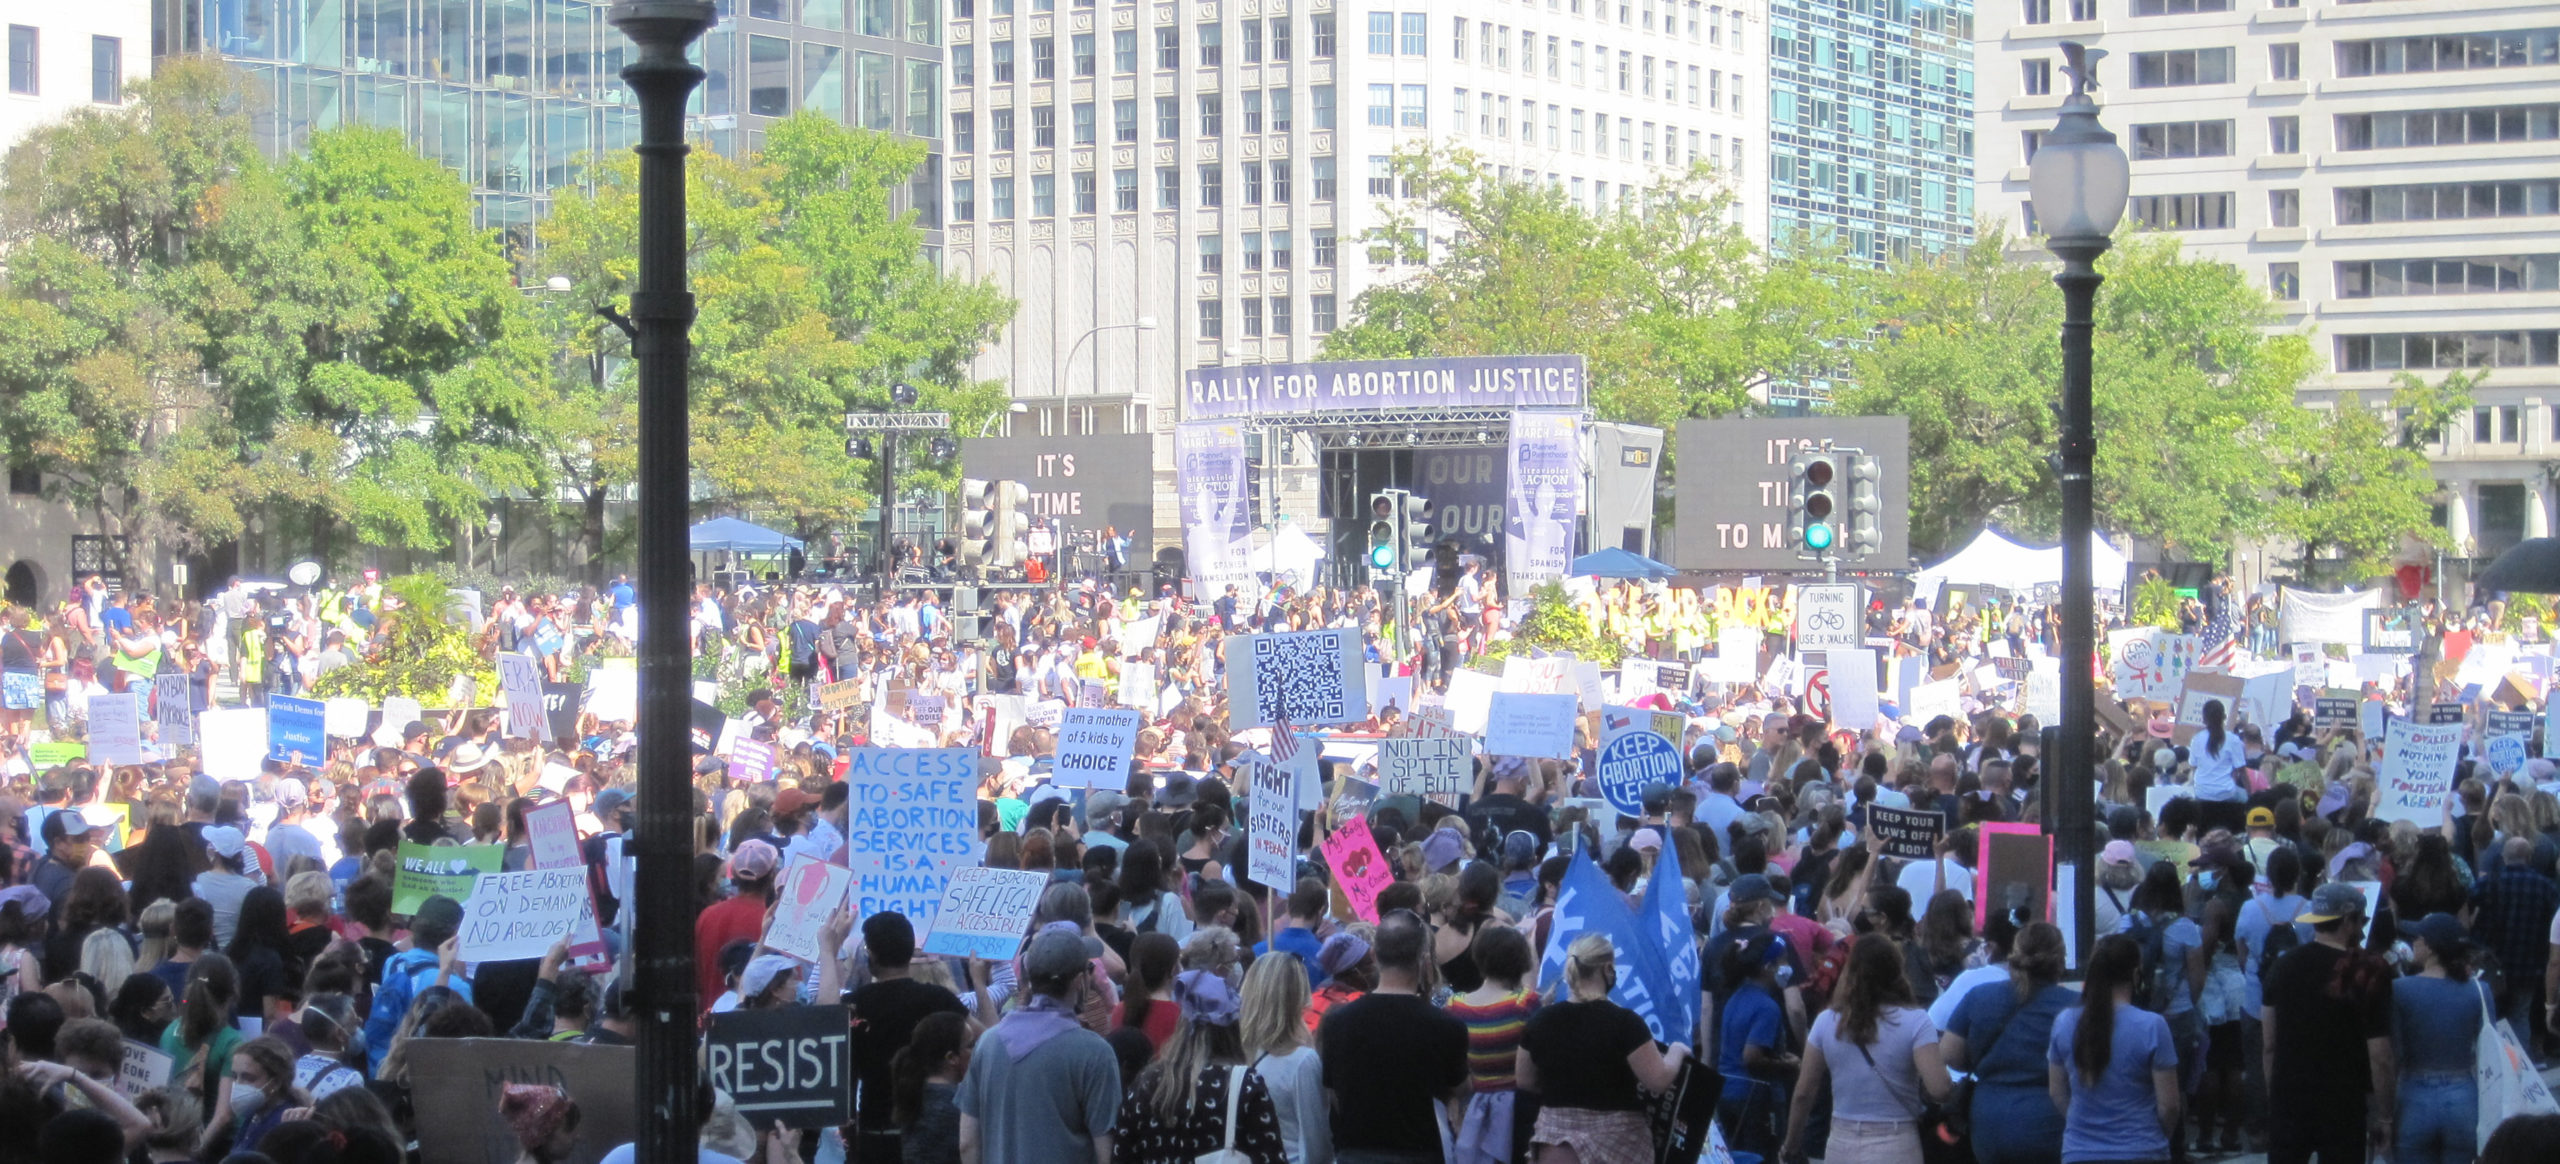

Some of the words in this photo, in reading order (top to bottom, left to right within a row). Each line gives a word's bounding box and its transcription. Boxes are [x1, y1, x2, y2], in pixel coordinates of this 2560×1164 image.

[1191, 376, 1260, 403] RALLY
[1273, 374, 1318, 399] FOR
[1331, 369, 1455, 397] ABORTION
[1468, 367, 1576, 393] JUSTICE
[1181, 437, 1214, 449] MARCH
[1515, 428, 1549, 439] MARCH
[1036, 454, 1075, 477] IT'S
[1429, 455, 1492, 484] OUR
[1526, 475, 1568, 485] ACTION
[1030, 491, 1082, 515] TIME
[1441, 504, 1503, 534] OUR
[1717, 524, 1748, 549] TO
[1230, 547, 1246, 556] FOR
[1550, 546, 1565, 555] FOR
[1213, 561, 1247, 570] SPANISH
[1530, 559, 1564, 568] SPANISH
[1809, 591, 1845, 603] TURNING
[1800, 634, 1816, 644] USE
[502, 660, 538, 695] ERA
[1528, 661, 1555, 680] YOU
[159, 676, 171, 697] MY
[1518, 674, 1564, 694] DON'T
[270, 701, 294, 713] Jewish
[294, 704, 314, 716] Dems
[314, 707, 325, 717] for
[511, 701, 543, 728] NOW
[1065, 711, 1069, 723] I
[1071, 715, 1085, 725] am
[1088, 715, 1094, 725] a
[1096, 713, 1133, 727] mother
[283, 730, 311, 744] Justice
[1067, 730, 1079, 743] of
[1080, 731, 1086, 744] 5
[1088, 731, 1110, 745] kids
[1111, 732, 1124, 748] by
[1610, 733, 1660, 761] KEEP
[1385, 739, 1425, 758] NOT
[1434, 738, 1464, 756] IN
[2398, 748, 2448, 762] NOTHING
[853, 752, 972, 777] ACCESS
[1062, 752, 1118, 772] CHOICE
[1392, 757, 1460, 777] SPITE
[1601, 750, 1678, 787] ABORTION
[1254, 761, 1292, 798] FIGHT
[2405, 767, 2441, 781] YOUR
[856, 783, 889, 804] TO
[899, 780, 964, 804] SAFE
[1424, 776, 1460, 794] BUT
[1257, 789, 1269, 807] for
[1271, 801, 1286, 814] our
[855, 807, 976, 830] ABORTION
[1876, 811, 1901, 823] KEEP
[1905, 815, 1935, 828] YOUR
[1250, 812, 1292, 846] SISTERS
[1326, 837, 1343, 855] My
[1340, 821, 1364, 840] Body
[1878, 825, 1906, 839] LAWS
[1911, 831, 1932, 841] OFF
[853, 831, 970, 855] SERVICES
[1255, 837, 1262, 849] IN
[1263, 840, 1289, 859] TEXAS
[1899, 843, 1928, 855] BODY
[405, 857, 423, 871] WE
[424, 859, 446, 874] ALL
[884, 854, 908, 871] IS
[914, 854, 934, 871] A
[479, 873, 534, 895] FREE
[538, 871, 585, 891] ABORTION
[954, 868, 989, 882] KEEP
[991, 872, 1046, 887] ABORTION
[478, 898, 508, 918] ON
[519, 894, 577, 915] DEMAND
[467, 920, 500, 944] NO
[503, 918, 575, 943] APOLOGY
[956, 913, 1028, 935] ACCESSIBLE
[123, 1046, 147, 1062] OVE
[709, 1034, 846, 1094] RESIST
[122, 1063, 151, 1082] EONE
